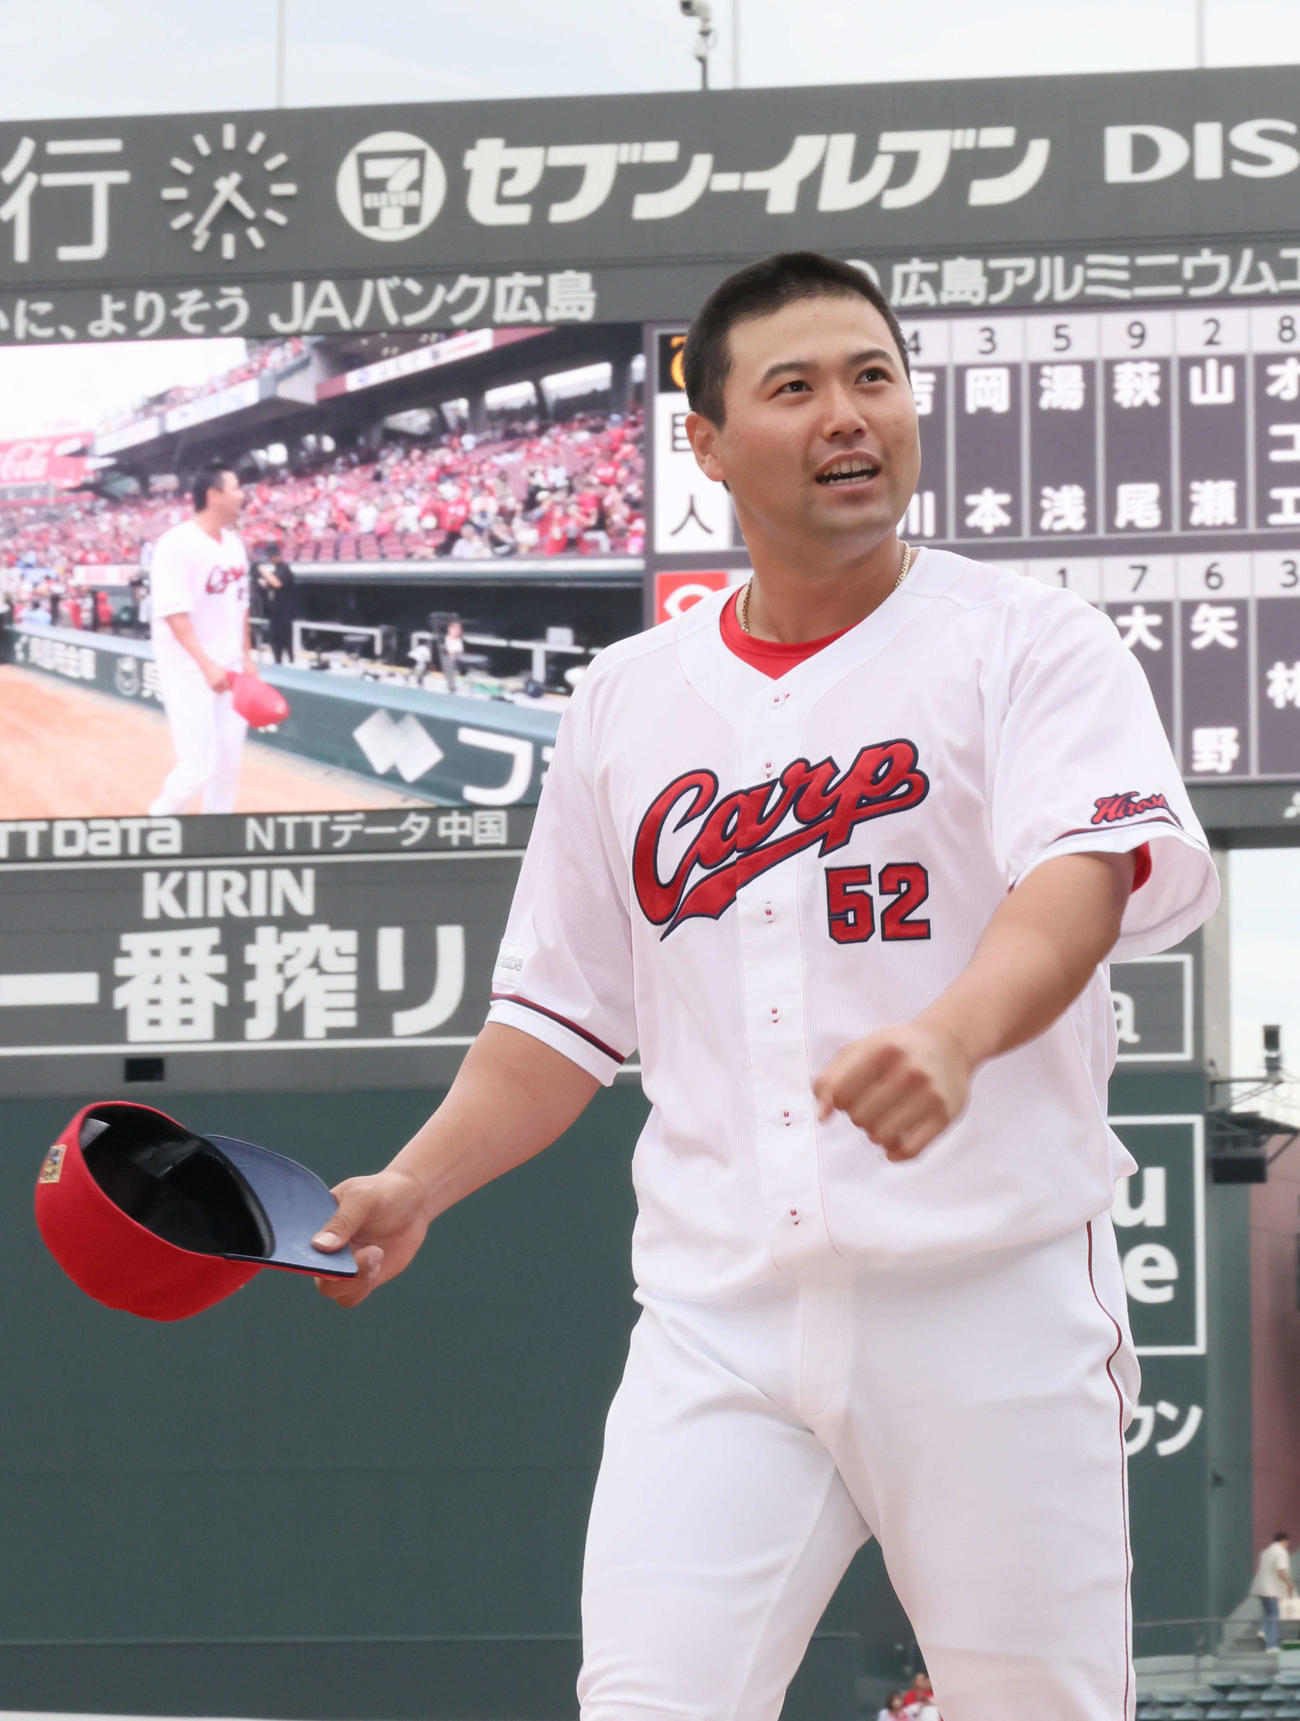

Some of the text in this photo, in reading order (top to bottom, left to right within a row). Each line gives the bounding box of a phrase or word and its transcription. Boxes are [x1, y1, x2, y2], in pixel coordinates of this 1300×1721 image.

[0, 137, 131, 263] 行
[1104, 118, 1300, 184] DIS
[269, 270, 597, 333] JAバンク広島
[978, 326, 997, 355] 3
[1054, 323, 1071, 351] 5
[1127, 320, 1146, 349] 9
[1203, 317, 1221, 346] 2
[1277, 315, 1297, 344] 8
[964, 366, 1013, 535] 岡本
[1039, 363, 1086, 532] 湯浅
[1188, 357, 1237, 527] 山瀬
[1265, 356, 1300, 527] オコエ
[1128, 564, 1149, 593] 7
[1204, 562, 1224, 591] 6
[1279, 559, 1300, 589] 3
[1190, 602, 1240, 774] 矢野
[142, 868, 316, 920] KIRIN
[632, 738, 930, 942] Carp
[824, 862, 931, 944] 52
[0, 923, 465, 1043] 一番搾り
